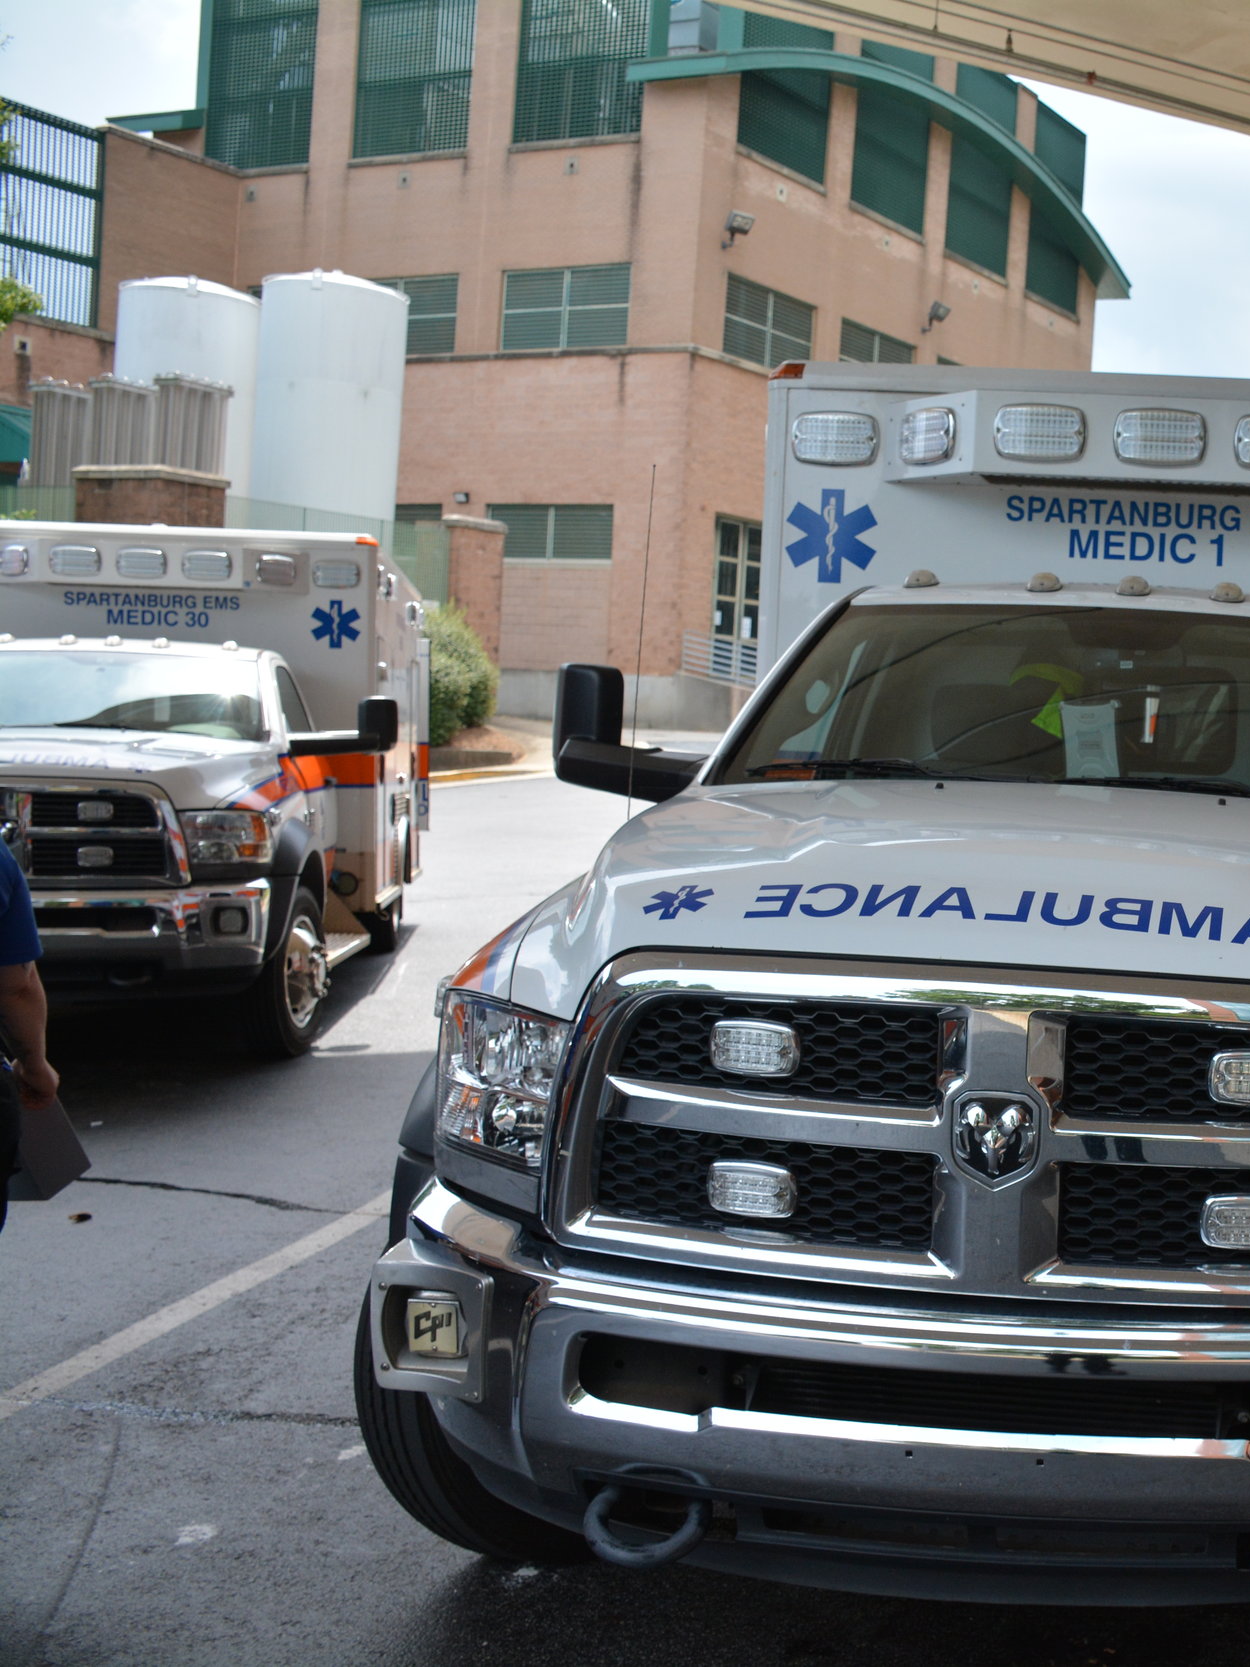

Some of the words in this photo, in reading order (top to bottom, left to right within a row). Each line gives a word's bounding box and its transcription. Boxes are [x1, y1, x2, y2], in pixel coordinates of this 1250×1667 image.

[1005, 495, 1242, 532] SPARTANBURG
[1068, 528, 1196, 565] MEDIC
[1210, 533, 1225, 567] 1
[63, 590, 197, 611] SPARTANBURG
[203, 594, 240, 611] EMS
[106, 608, 180, 628] MEDIC
[184, 610, 210, 630] 30
